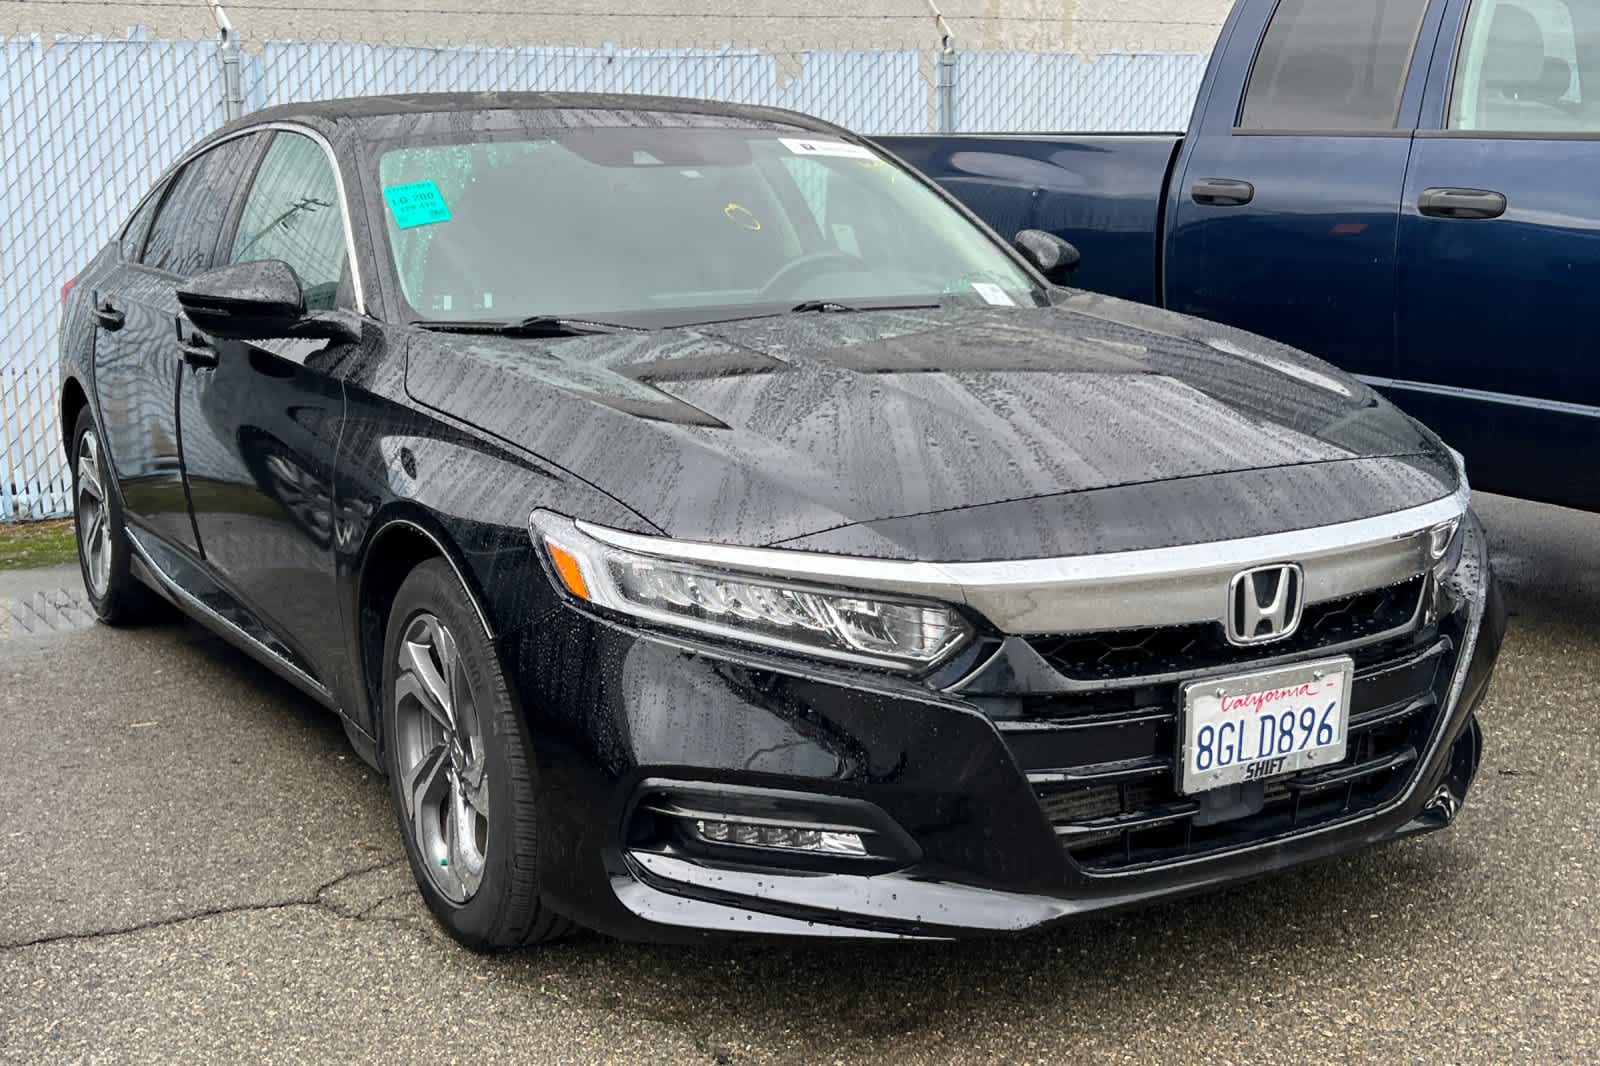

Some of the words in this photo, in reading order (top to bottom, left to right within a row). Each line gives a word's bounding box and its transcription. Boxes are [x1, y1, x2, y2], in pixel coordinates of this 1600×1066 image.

[1219, 682, 1319, 713] California
[1196, 701, 1336, 771] 8GLD896
[1245, 757, 1287, 779] SHIFT
